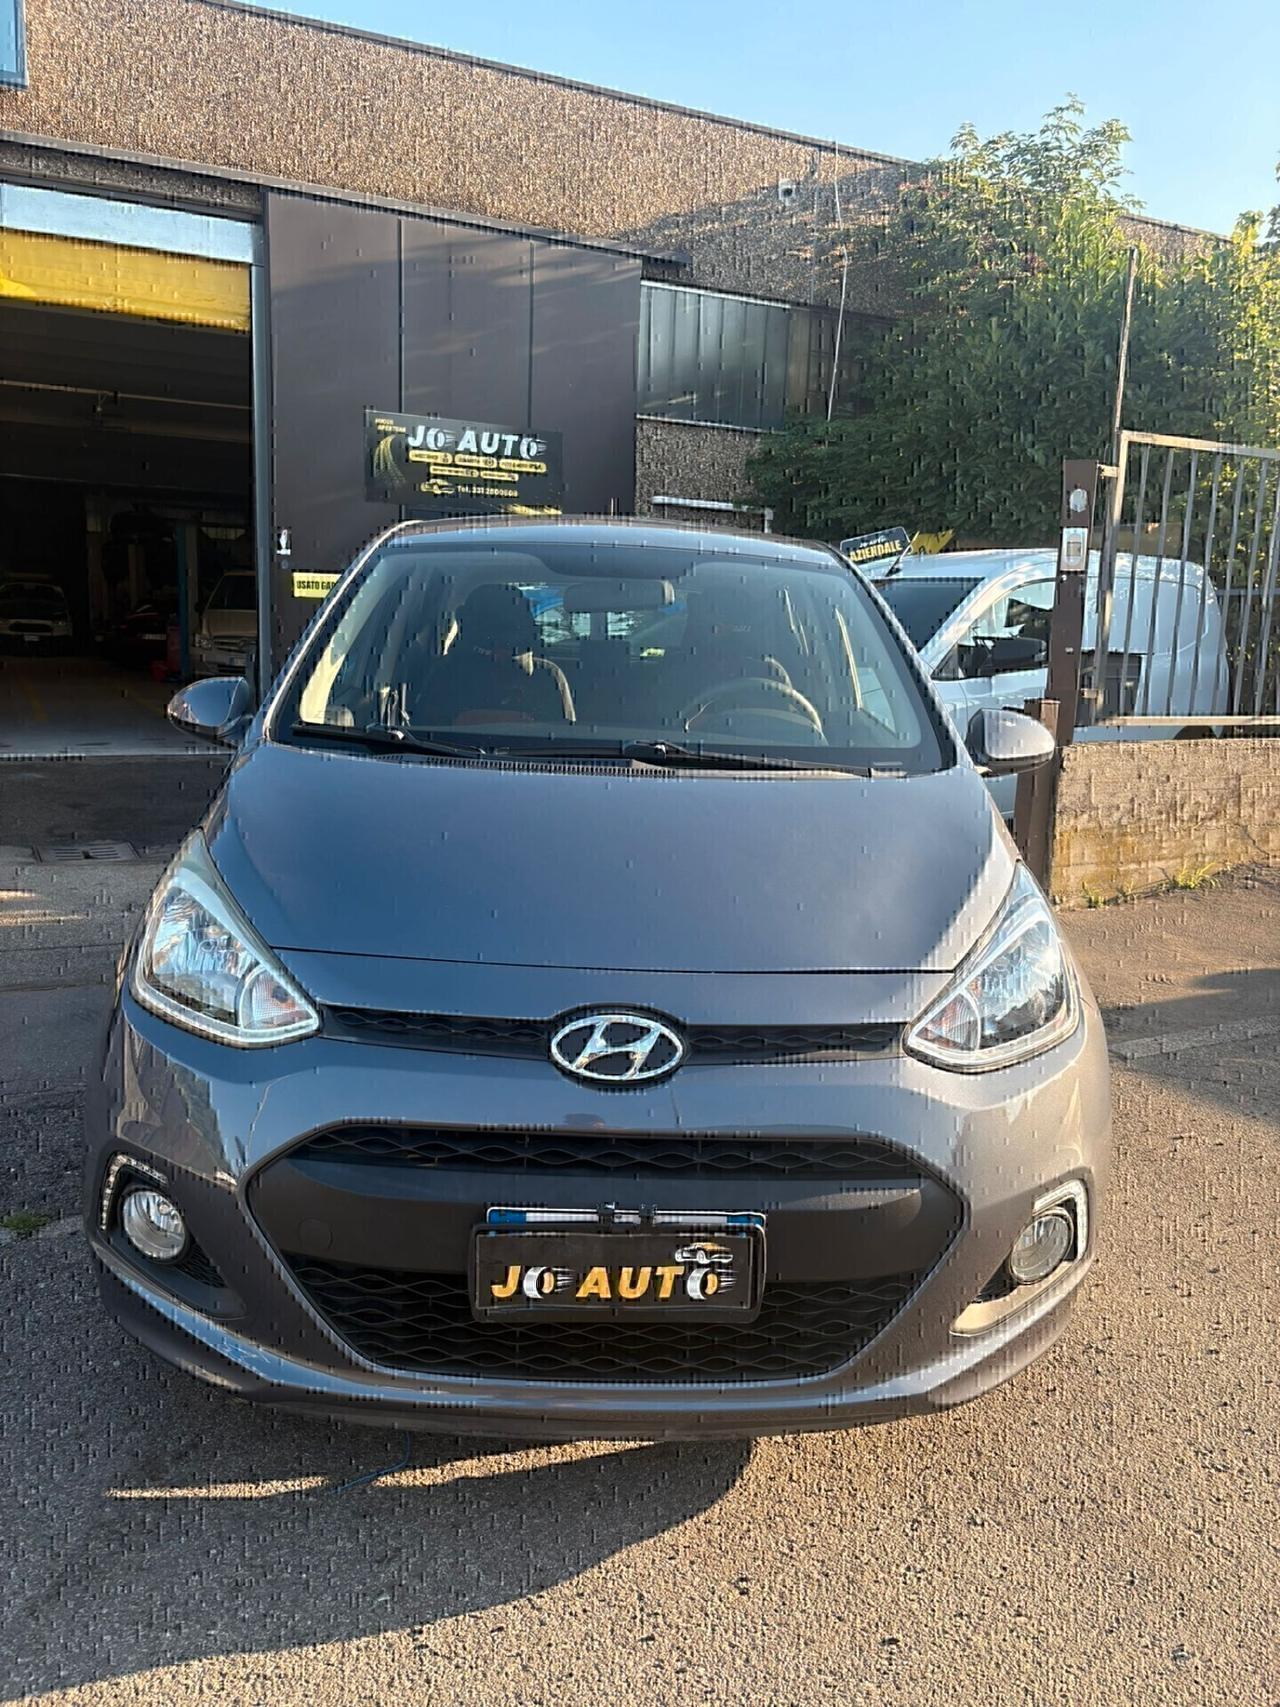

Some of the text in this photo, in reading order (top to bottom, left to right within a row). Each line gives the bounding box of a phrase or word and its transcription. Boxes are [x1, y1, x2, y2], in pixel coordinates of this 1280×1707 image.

[407, 425, 543, 460] JO AUTO
[849, 540, 903, 562] AZIENDALE
[296, 580, 320, 590] USATO
[490, 1265, 727, 1301] JO AUTO
